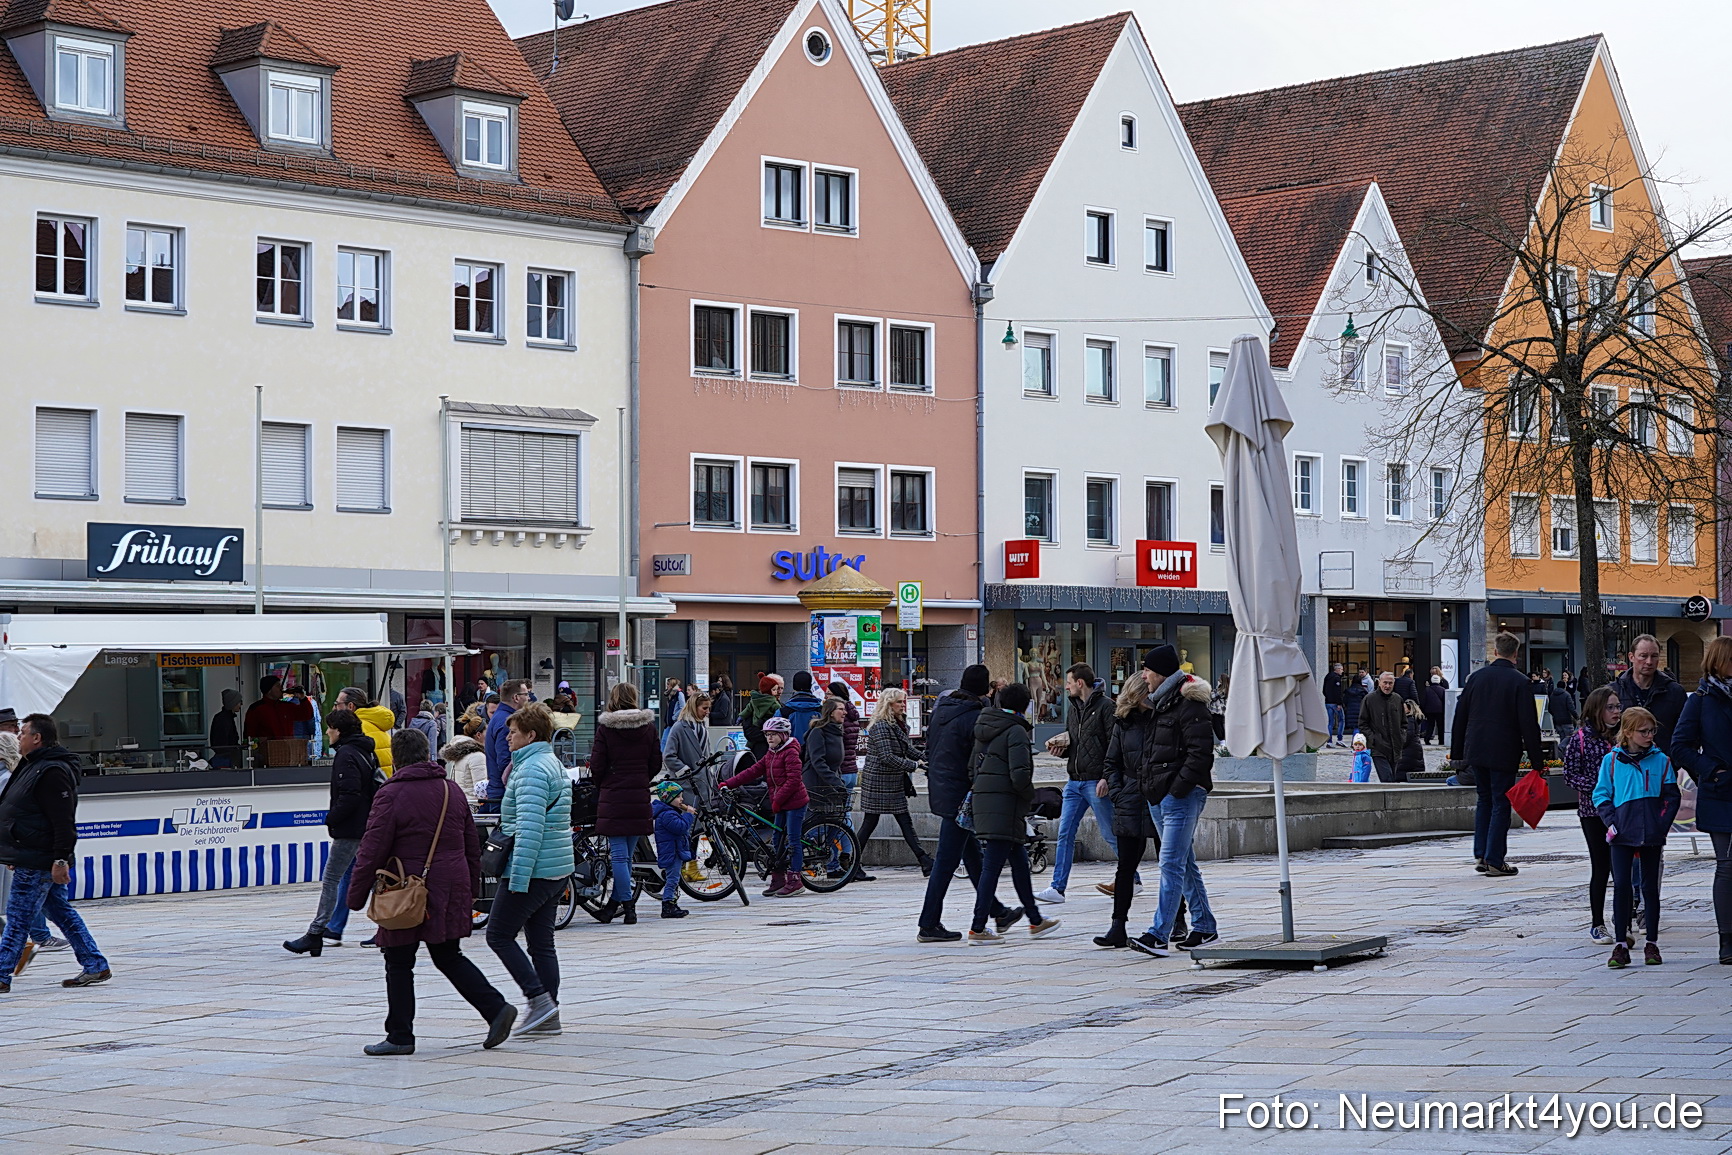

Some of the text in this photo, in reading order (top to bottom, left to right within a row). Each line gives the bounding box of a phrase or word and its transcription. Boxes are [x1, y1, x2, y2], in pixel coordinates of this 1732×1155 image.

[96, 529, 239, 576] frühauf
[1008, 552, 1030, 563] WITT
[1150, 548, 1193, 572] WITT
[1157, 571, 1181, 581] weiden
[104, 654, 139, 666] Langos
[161, 653, 236, 666] Fischsemmel
[196, 797, 231, 807] Der Imbiss
[190, 805, 235, 825] LANG
[180, 824, 240, 837] Die Fischbraterei
[194, 836, 226, 846] seit 1900
